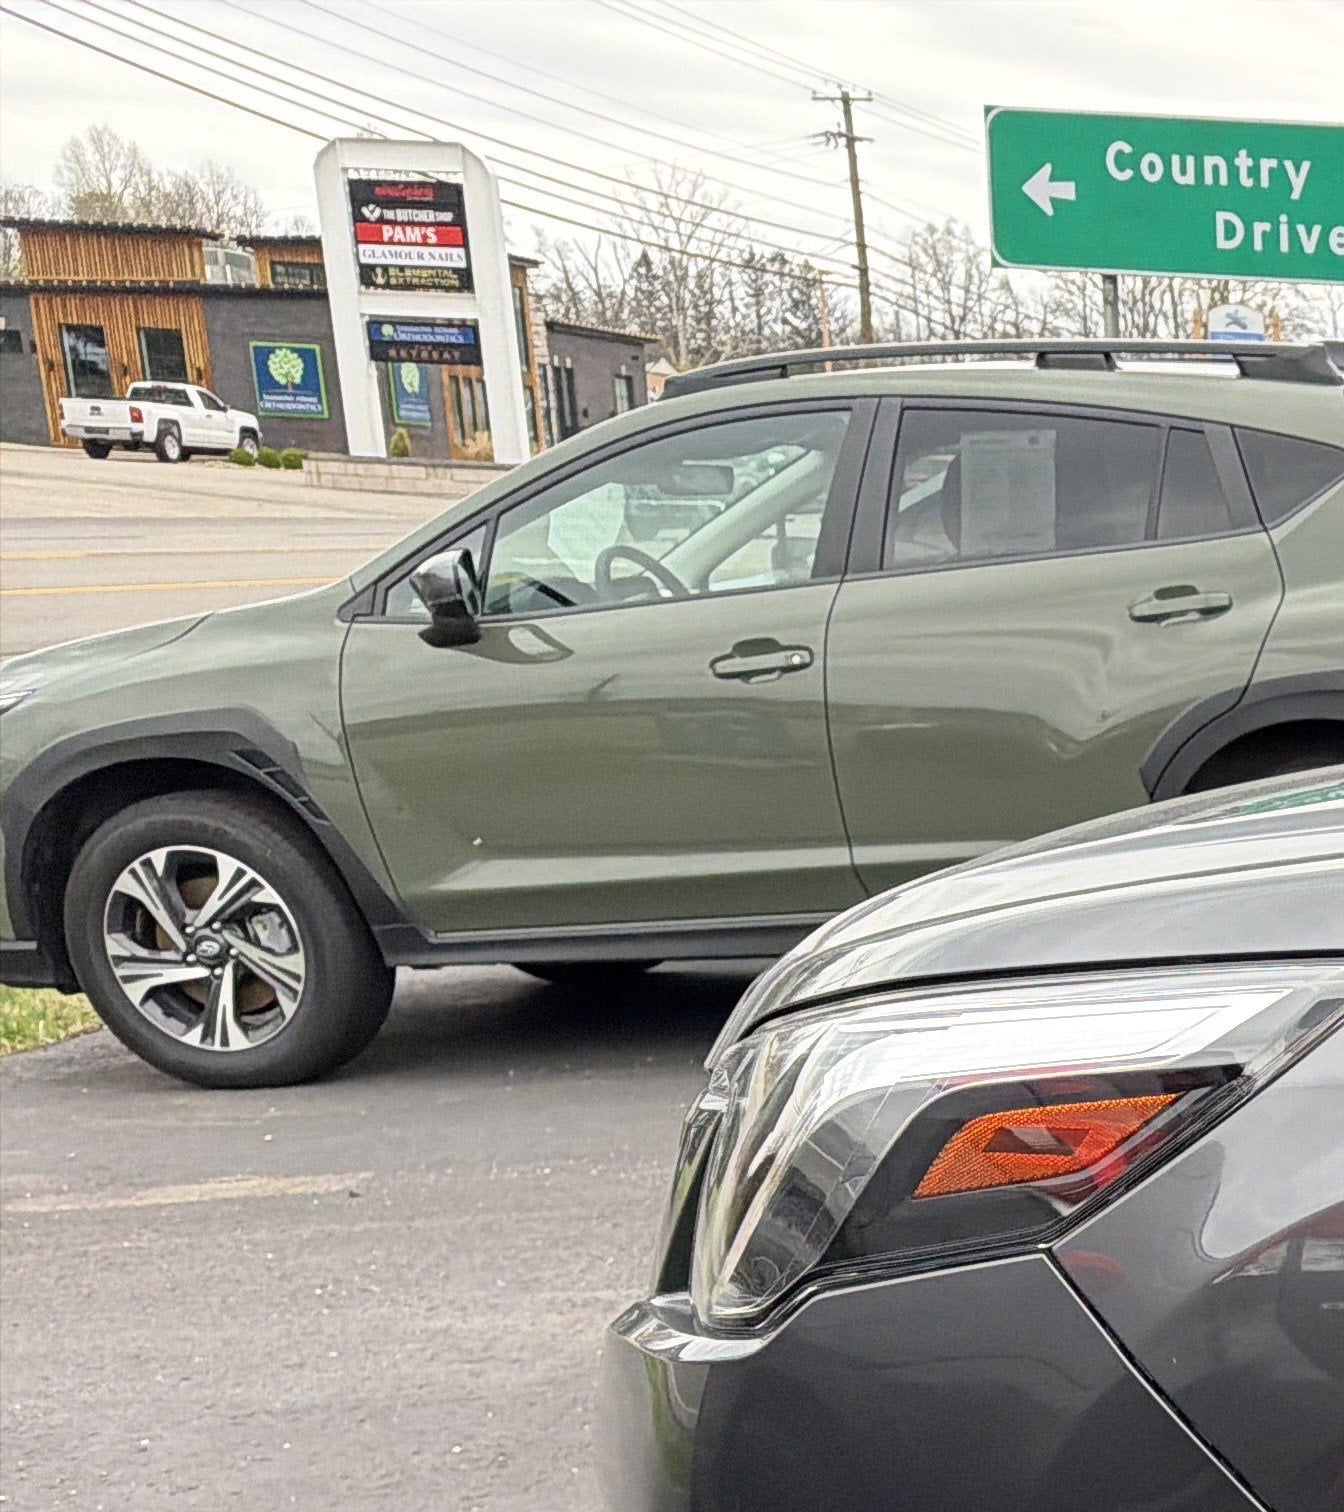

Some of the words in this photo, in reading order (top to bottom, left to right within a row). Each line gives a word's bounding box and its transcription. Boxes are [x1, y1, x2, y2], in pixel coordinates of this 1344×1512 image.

[1106, 141, 1311, 200] Country
[381, 225, 439, 244] PAM'S
[362, 248, 425, 262] GLAMOUR
[428, 250, 464, 262] NAILS
